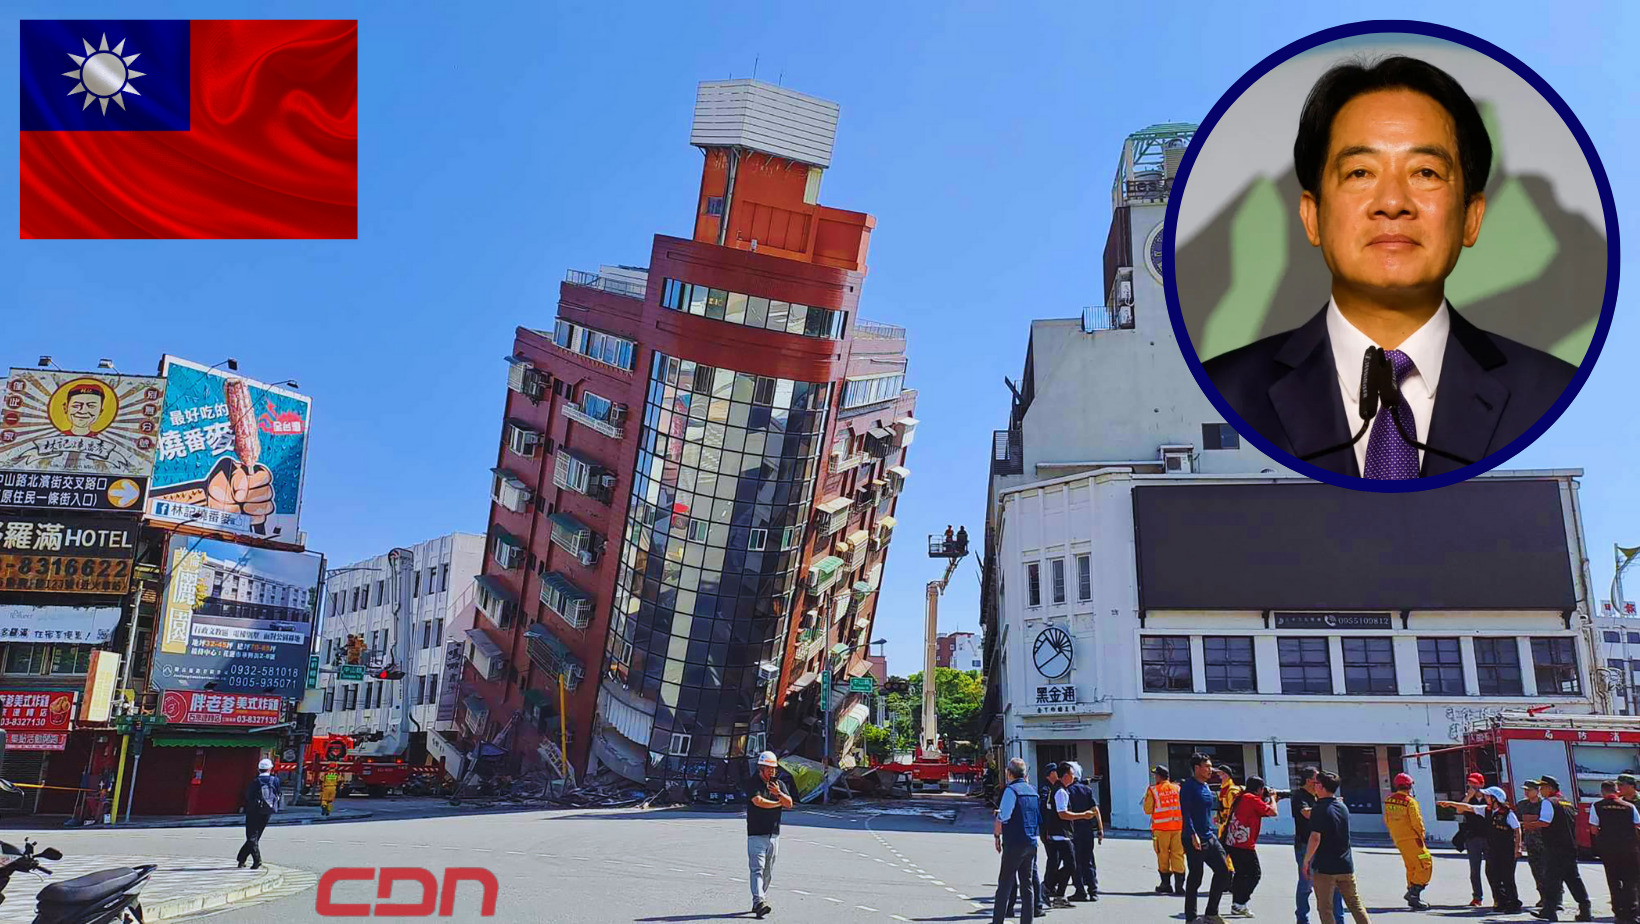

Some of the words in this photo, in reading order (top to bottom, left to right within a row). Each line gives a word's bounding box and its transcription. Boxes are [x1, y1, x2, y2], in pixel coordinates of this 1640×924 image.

[169, 404, 229, 426] 最好吃的
[230, 664, 298, 678] 0932-581018
[228, 676, 297, 689] 0905-935071
[1036, 686, 1076, 704] 黑金通
